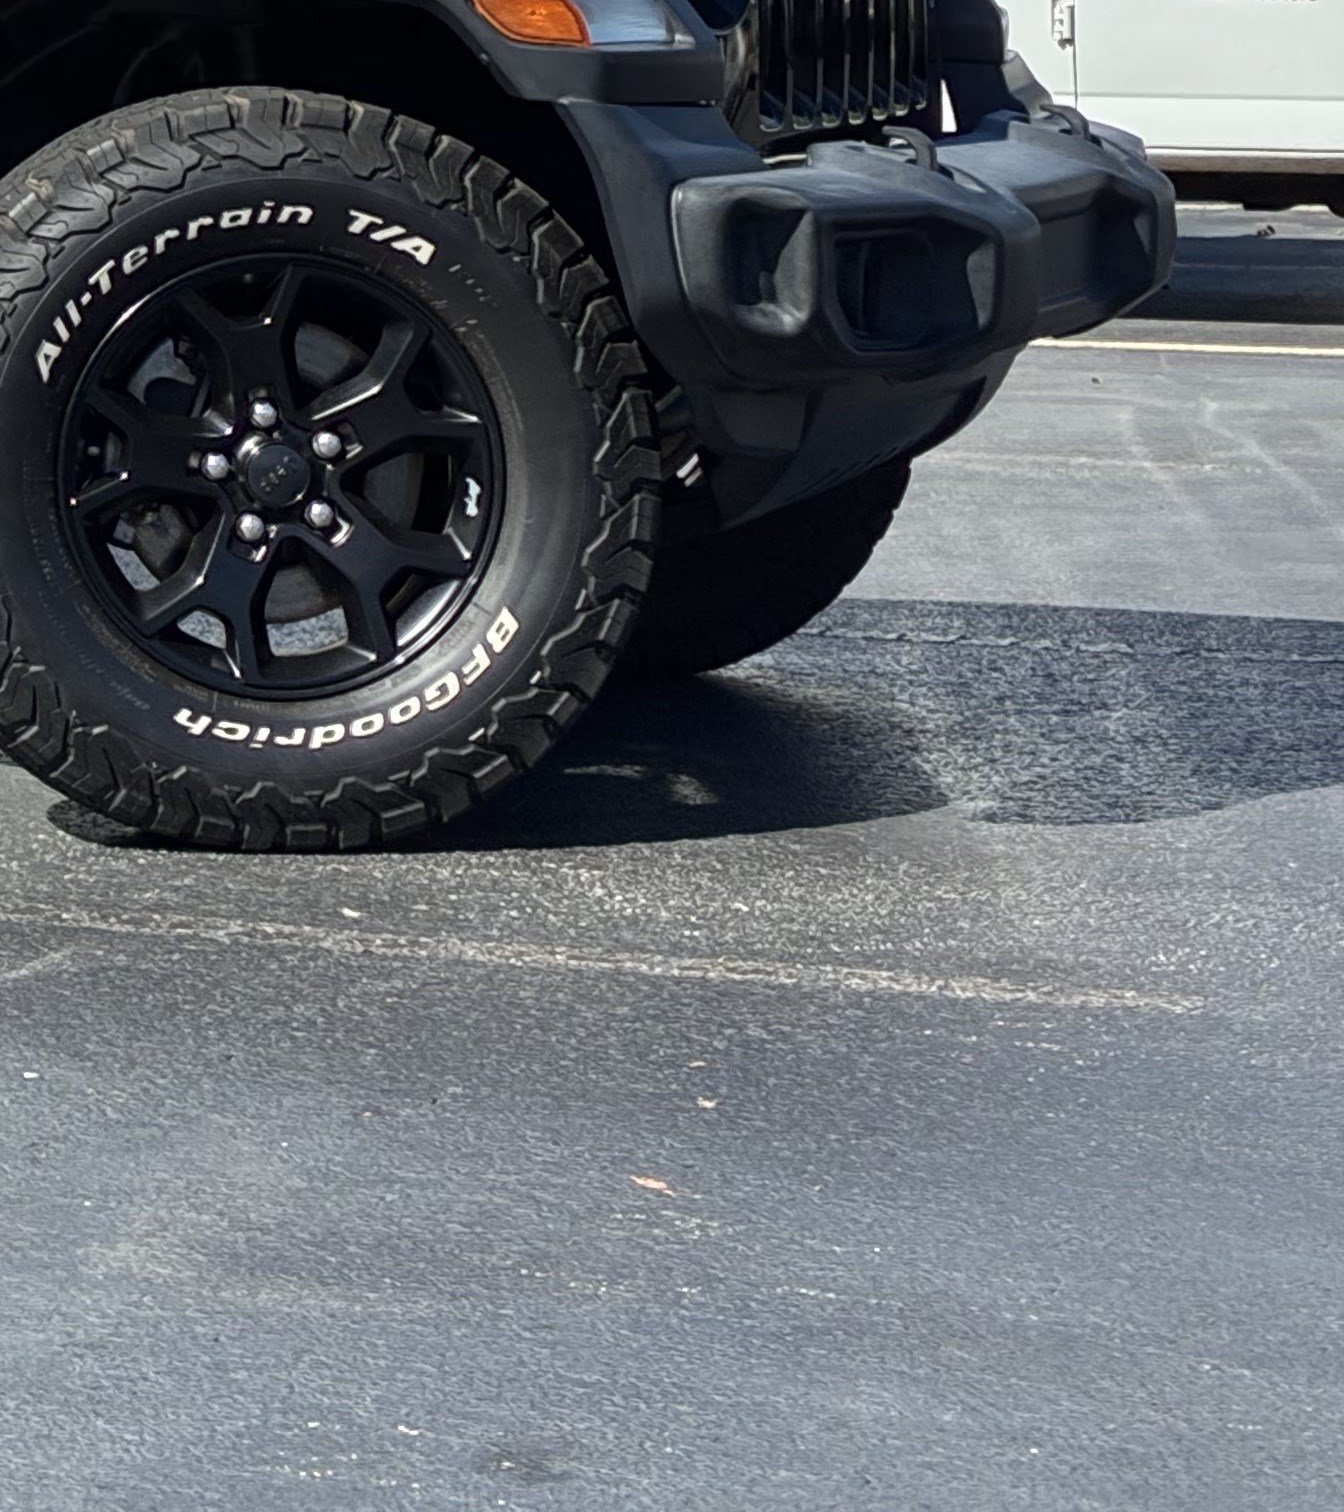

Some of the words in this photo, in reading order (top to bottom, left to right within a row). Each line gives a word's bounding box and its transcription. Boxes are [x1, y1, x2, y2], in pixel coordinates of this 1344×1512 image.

[34, 201, 314, 382] All-Terrain
[347, 208, 436, 267] T/A
[174, 607, 520, 749] BFGoodrich
